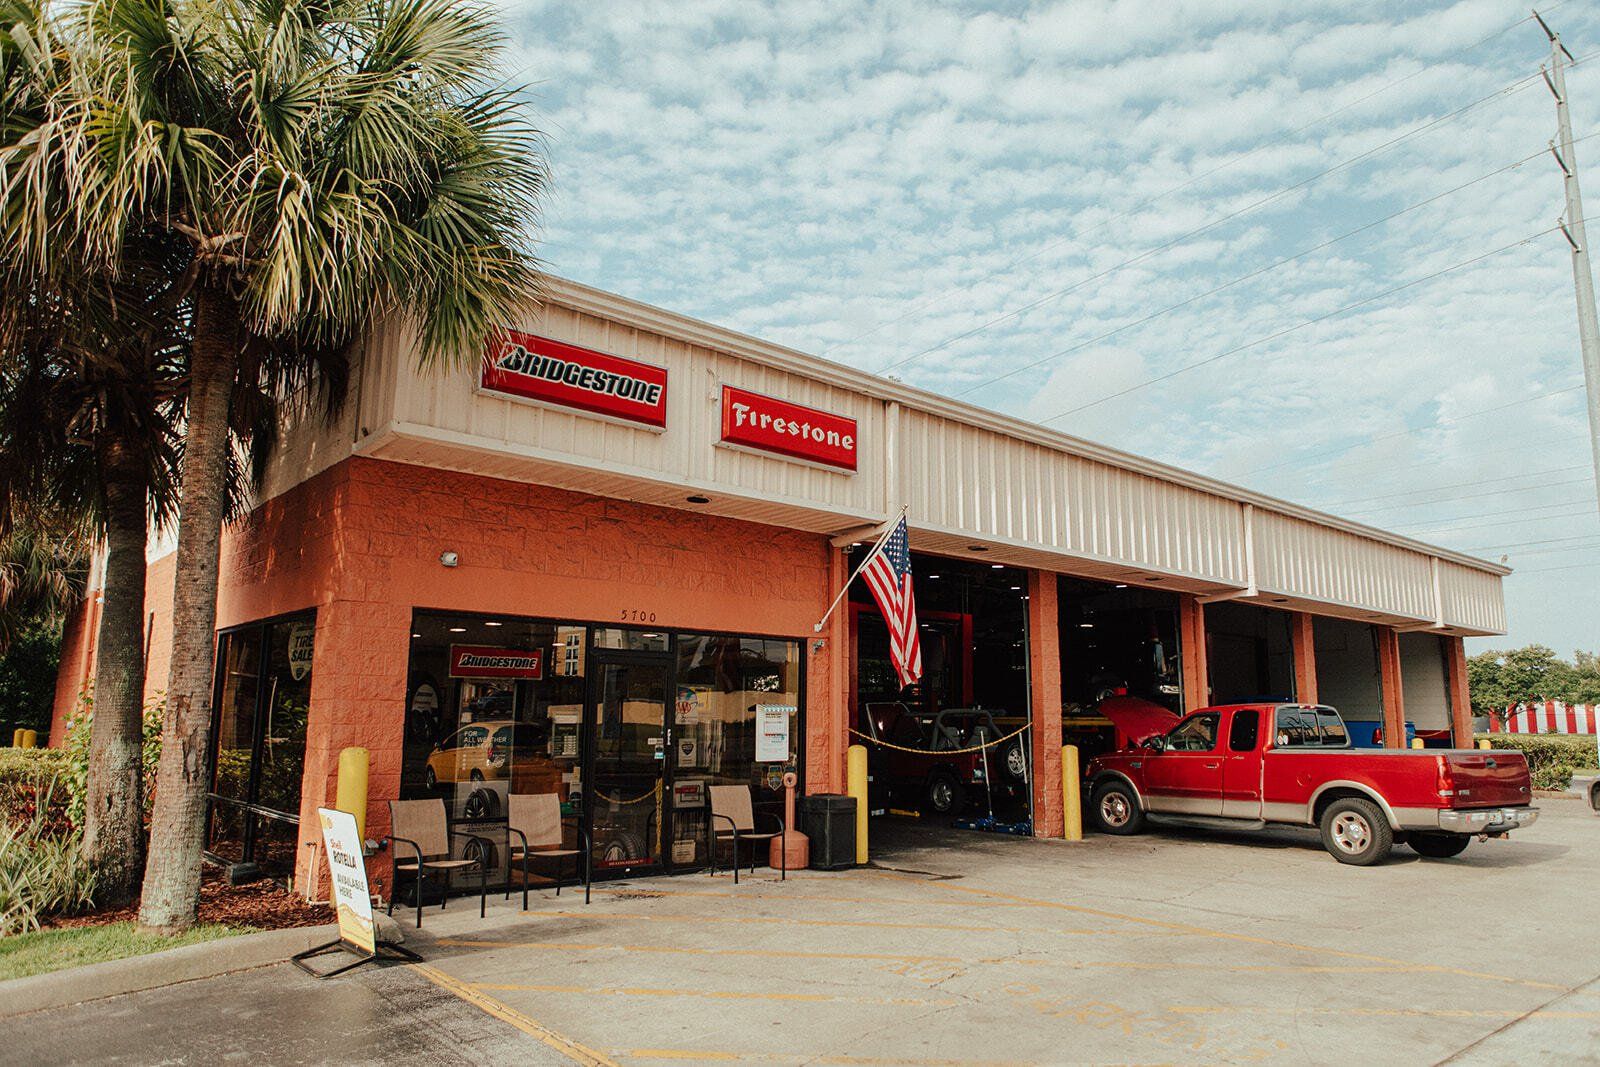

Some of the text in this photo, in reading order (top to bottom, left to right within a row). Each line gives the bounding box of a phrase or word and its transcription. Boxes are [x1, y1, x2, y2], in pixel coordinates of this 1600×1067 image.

[497, 342, 662, 407] BRIDGESTONE
[732, 402, 854, 451] Firestone
[621, 609, 656, 623] 5700
[291, 650, 313, 662] SALE
[458, 653, 538, 669] BRIDGESTONE
[333, 850, 357, 869] ROTELLA
